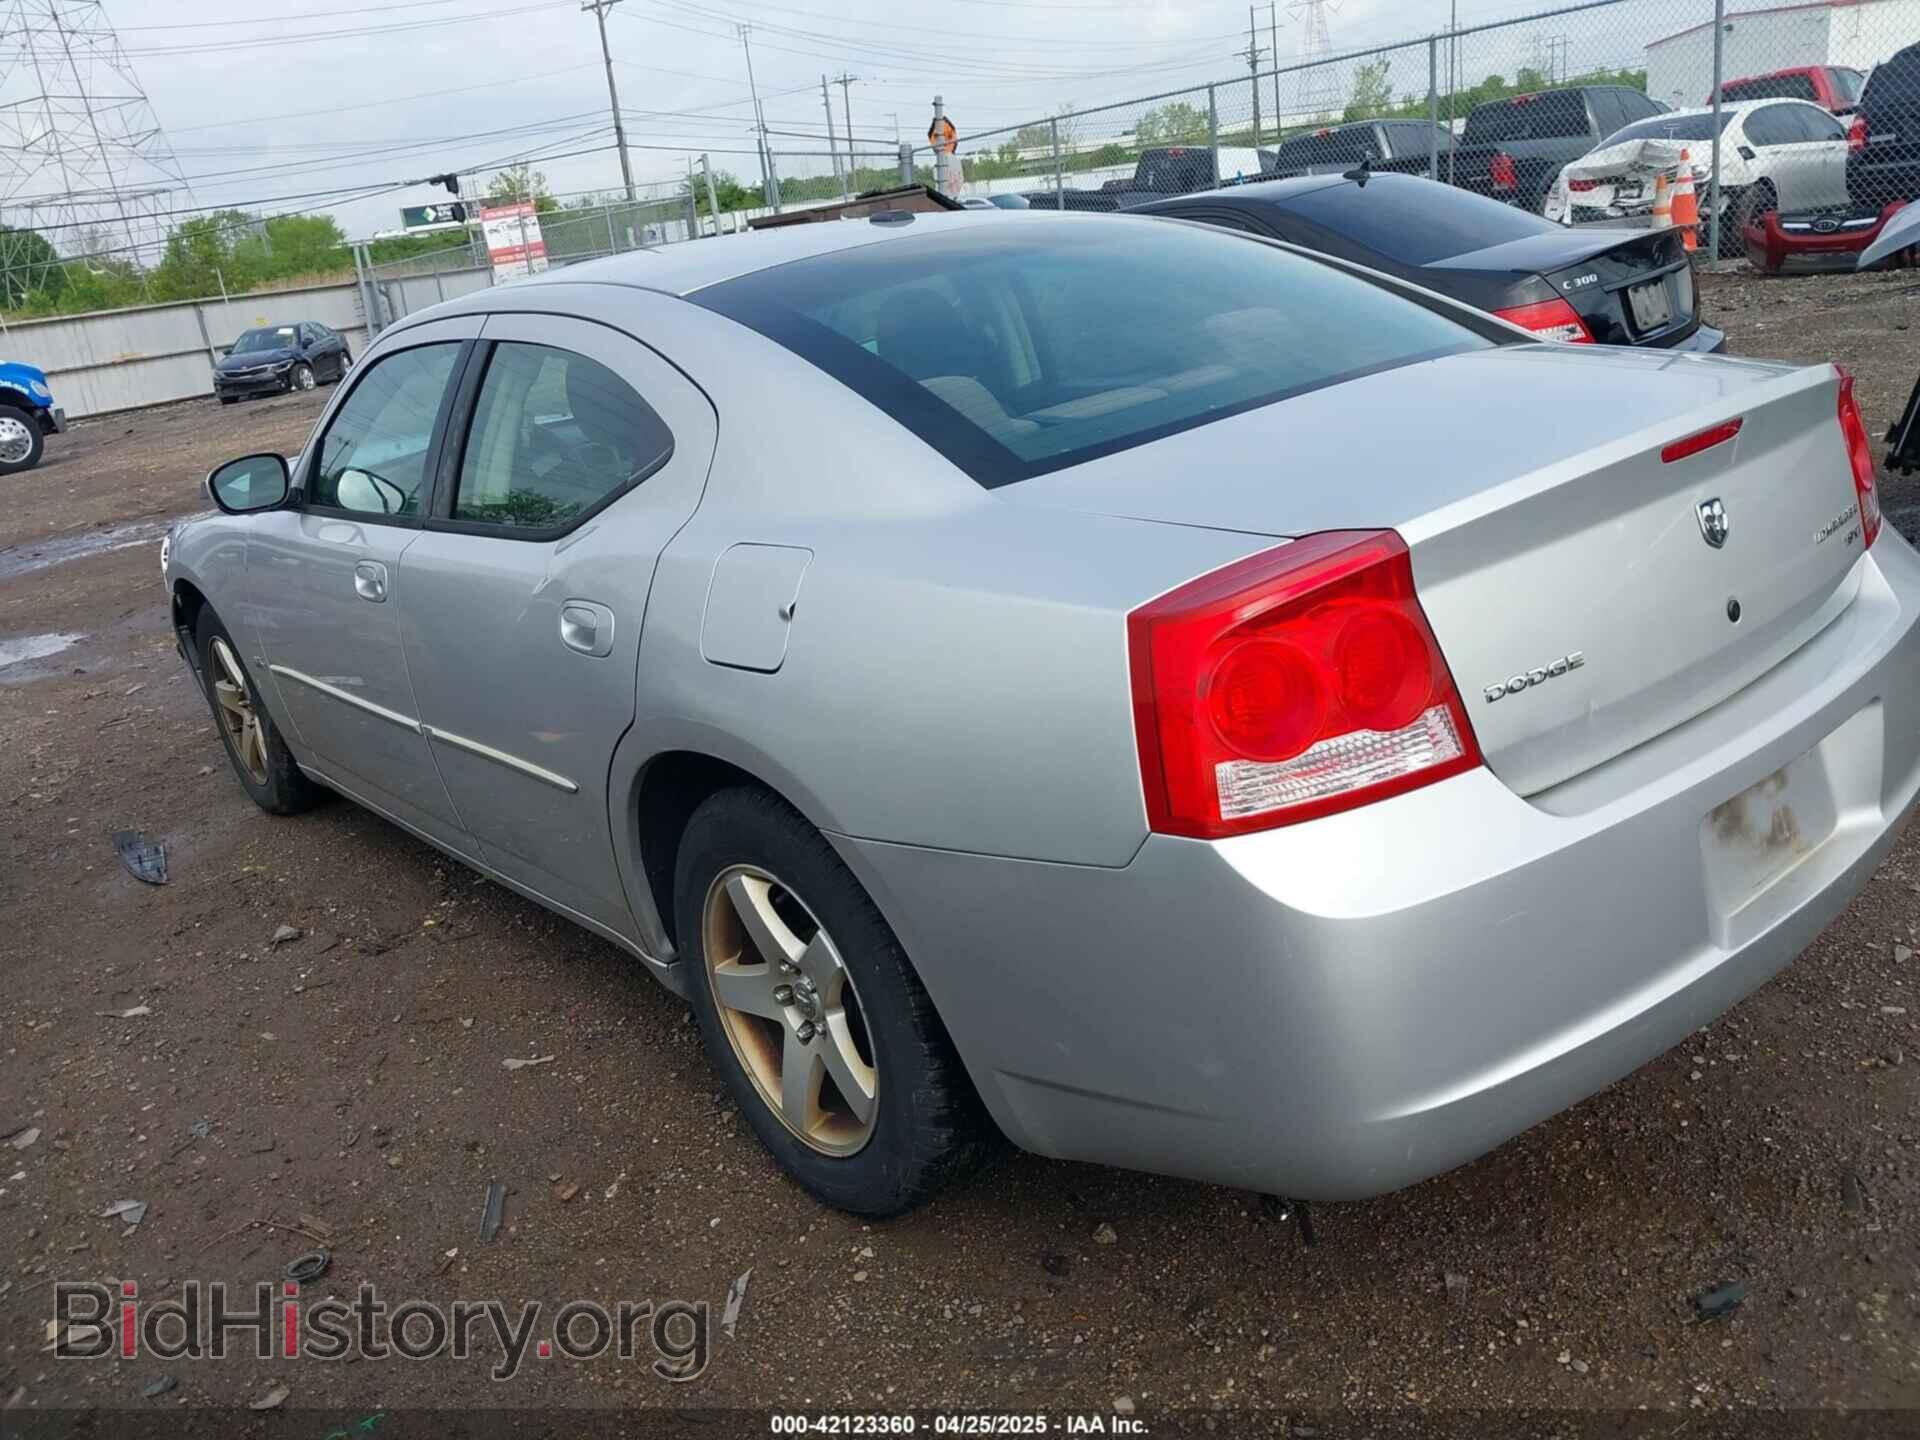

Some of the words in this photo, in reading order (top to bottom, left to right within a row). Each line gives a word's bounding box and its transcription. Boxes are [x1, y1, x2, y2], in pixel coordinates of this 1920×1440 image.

[1562, 280, 1572, 290] C
[1573, 273, 1598, 288] 300
[1483, 650, 1585, 704] DODGE
